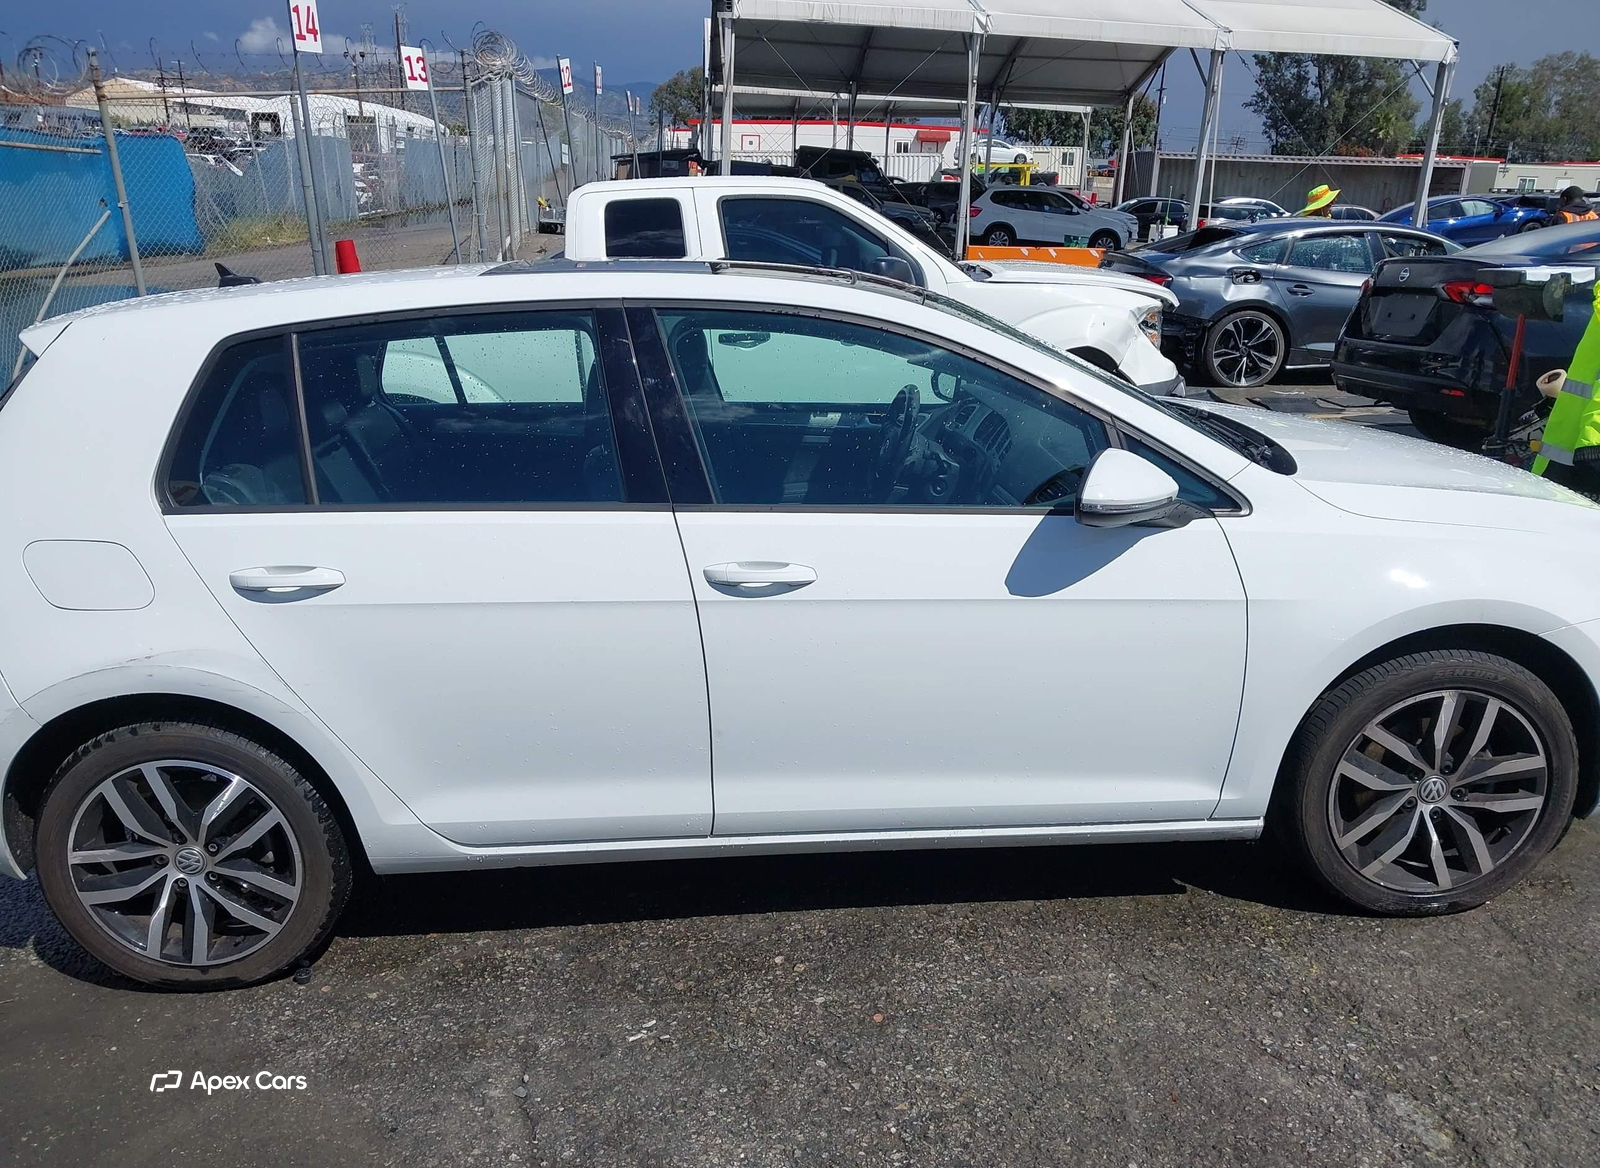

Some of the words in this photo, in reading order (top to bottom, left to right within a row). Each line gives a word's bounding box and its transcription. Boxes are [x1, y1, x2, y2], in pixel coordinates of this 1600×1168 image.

[292, 4, 318, 42] 14
[404, 55, 428, 82] 13
[561, 65, 572, 88] 12
[1432, 668, 1507, 683] SENTURY
